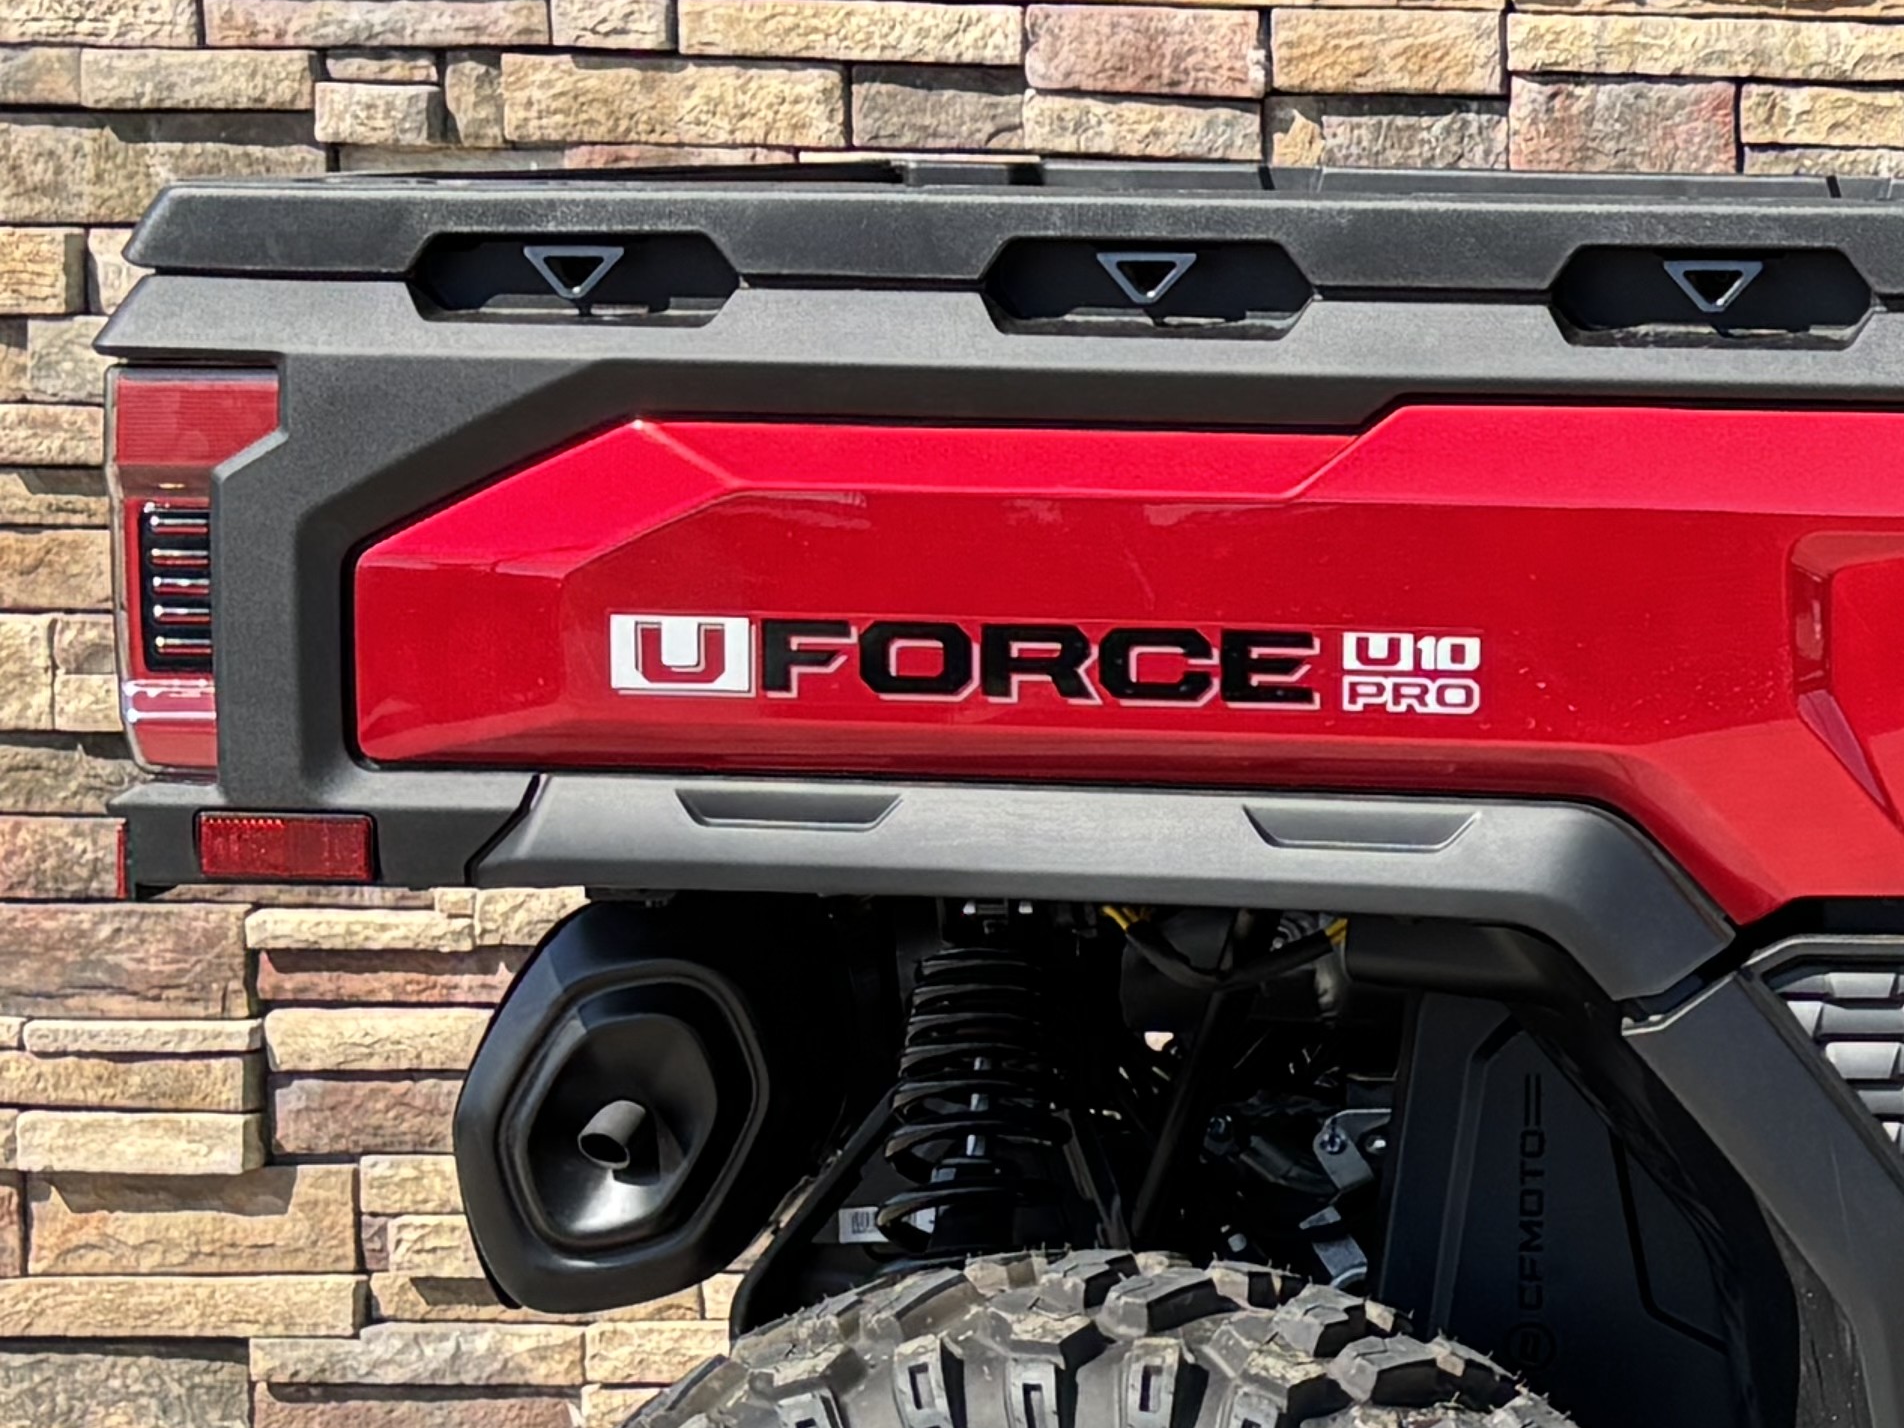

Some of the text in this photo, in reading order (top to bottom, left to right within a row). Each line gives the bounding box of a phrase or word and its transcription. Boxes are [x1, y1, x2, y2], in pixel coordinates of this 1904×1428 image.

[1341, 632, 1481, 672] U10
[1341, 675, 1480, 714] PRO
[1516, 1129, 1546, 1311] CFMOTO
